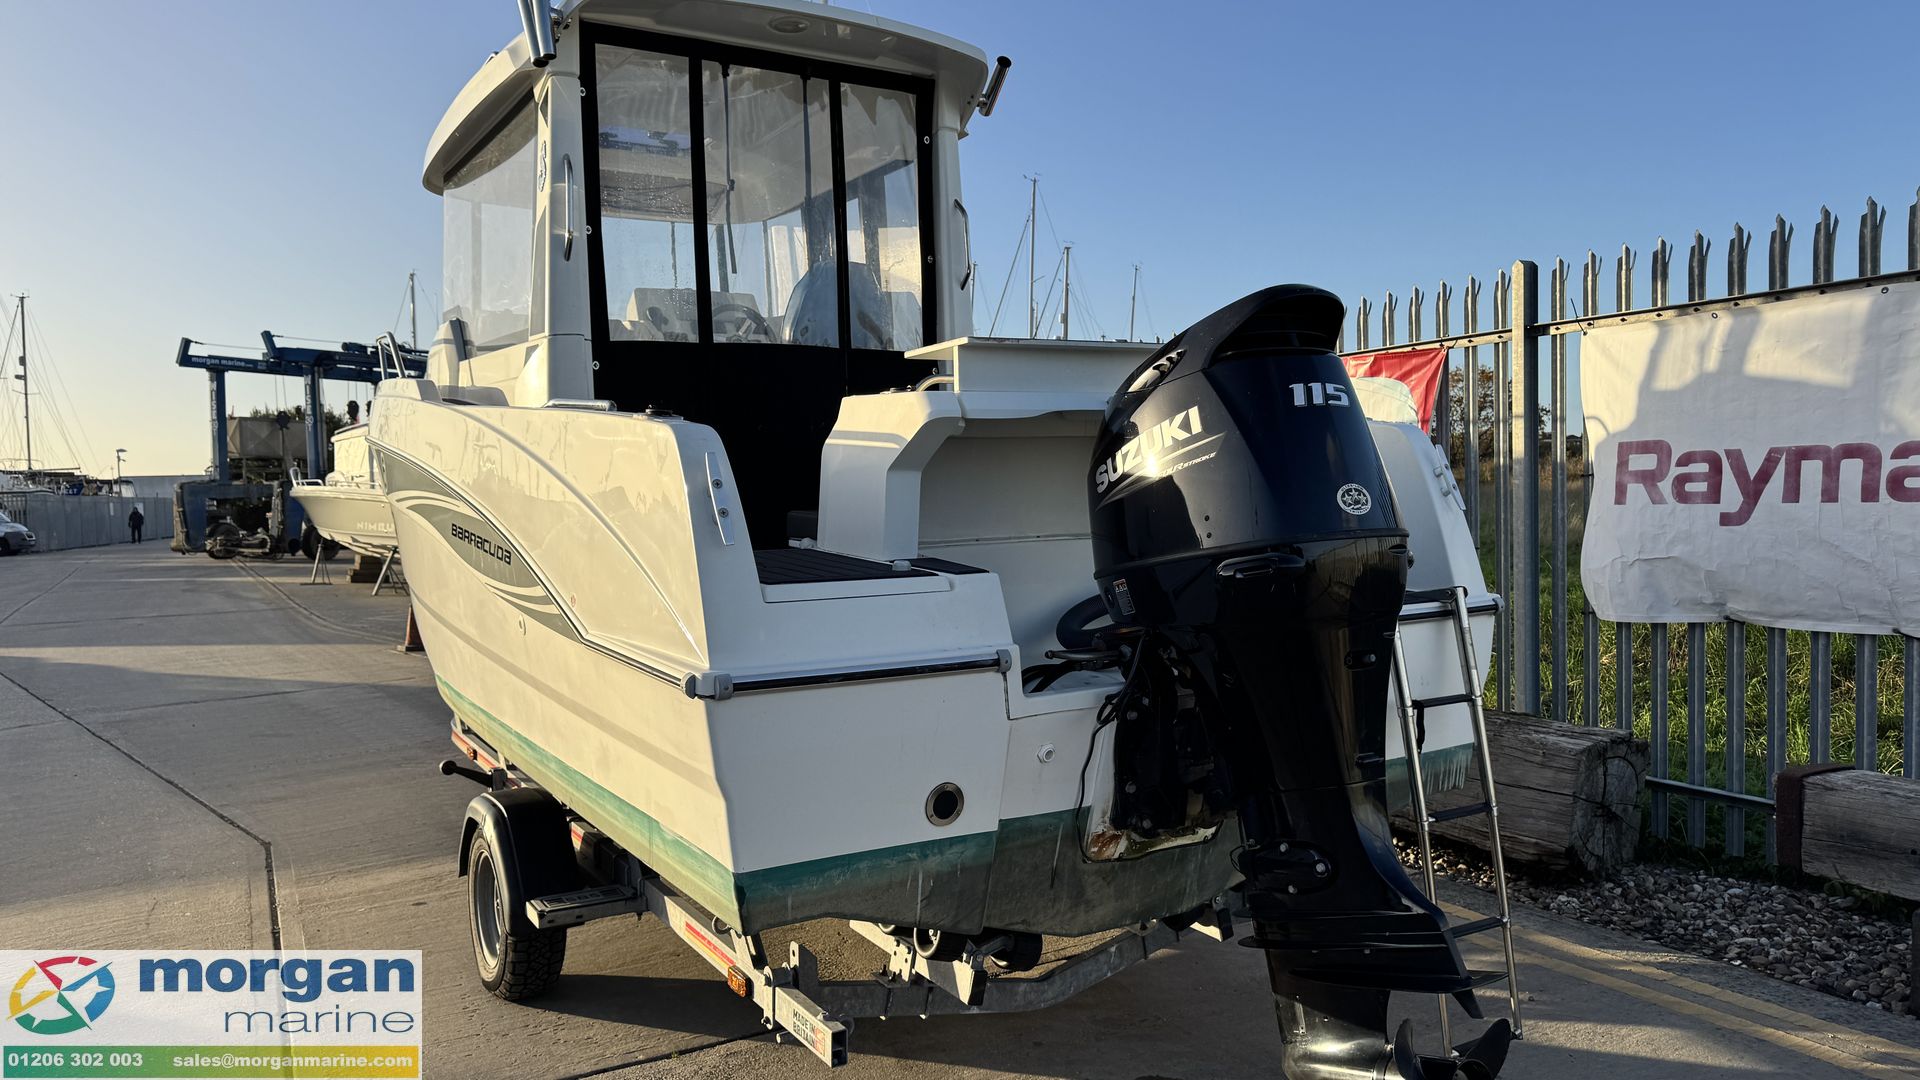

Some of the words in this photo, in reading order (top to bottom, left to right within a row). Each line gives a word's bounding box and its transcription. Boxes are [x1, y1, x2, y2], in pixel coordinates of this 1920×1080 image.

[191, 356, 220, 366] morgan
[1289, 382, 1349, 407] 115
[1095, 405, 1202, 494] SUZUKI
[1614, 439, 1920, 526] Rayma
[451, 523, 512, 566] BARRACUDA
[792, 1008, 809, 1030] MADE
